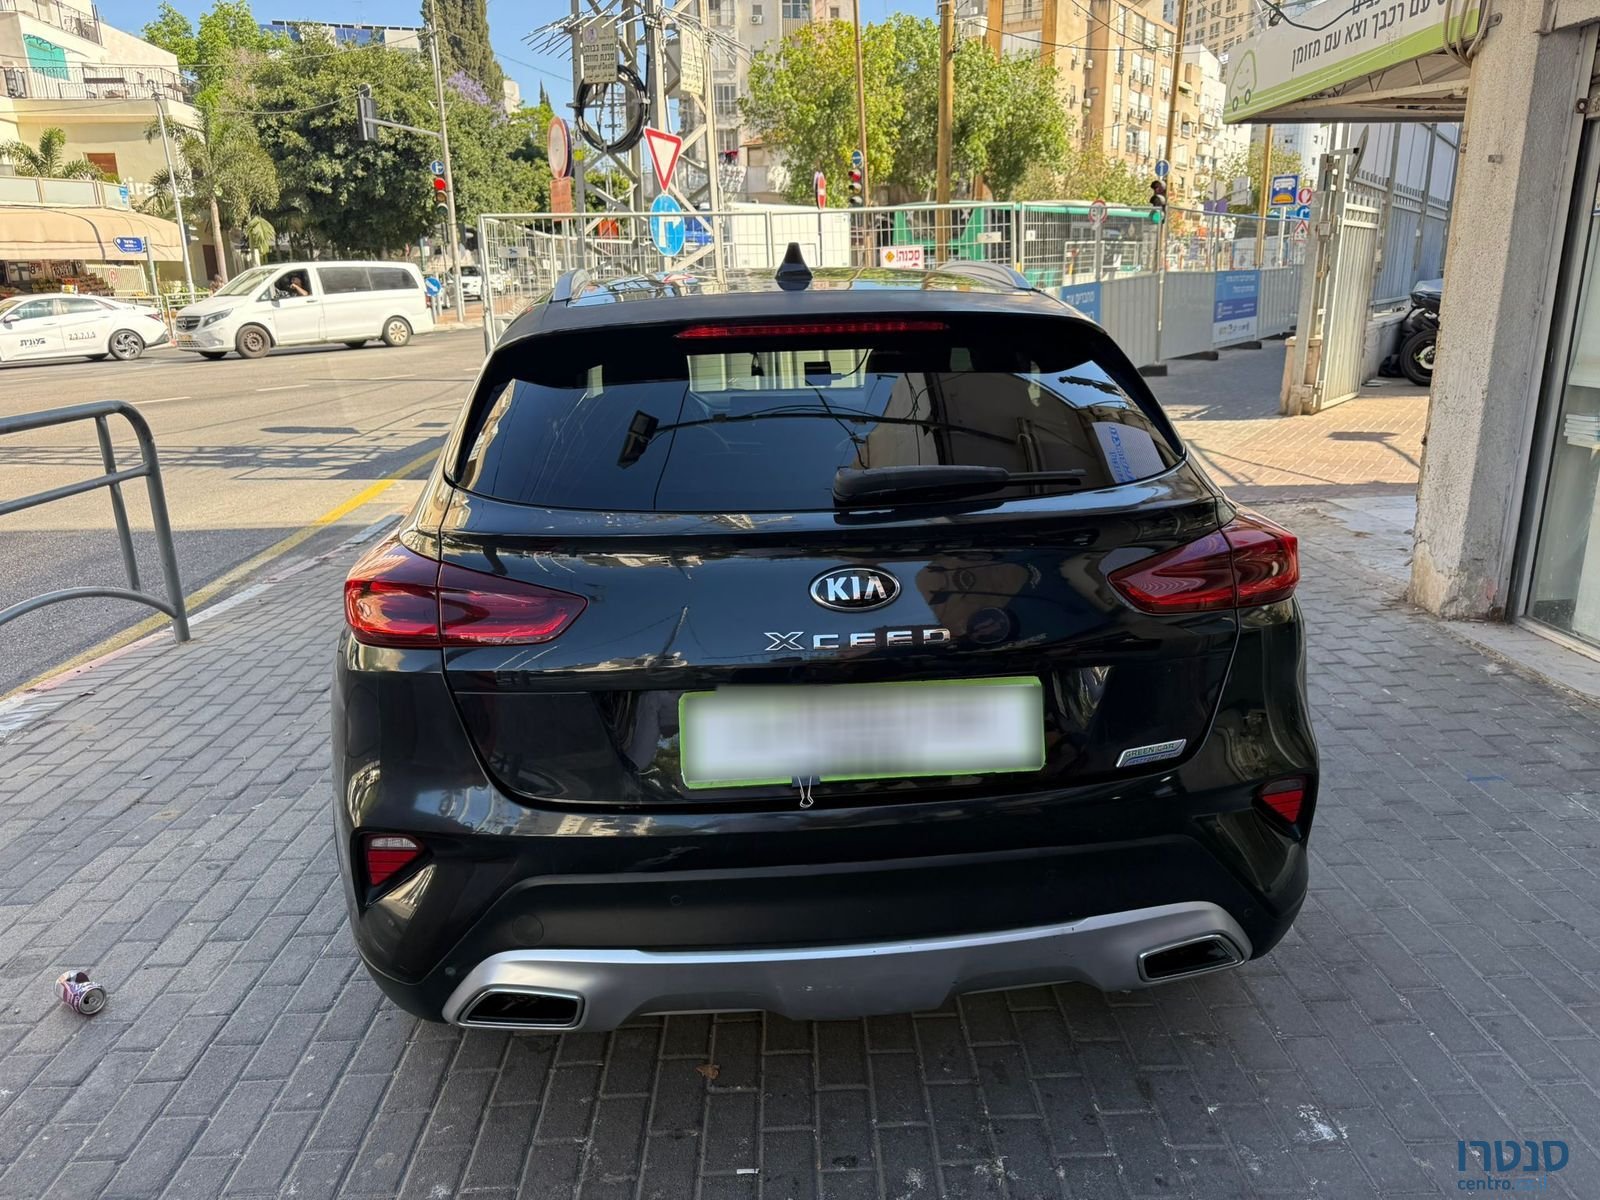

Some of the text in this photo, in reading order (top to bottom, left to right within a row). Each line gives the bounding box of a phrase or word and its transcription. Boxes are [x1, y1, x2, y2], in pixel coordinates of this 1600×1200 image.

[1344, 18, 1368, 45] וצא
[1372, 2, 1405, 39] רכבך
[1291, 37, 1321, 72] מזומן
[1324, 29, 1342, 54] עם
[896, 249, 920, 262] סכנה!
[825, 575, 888, 602] KIA
[764, 628, 952, 651] XCEED
[1126, 746, 1155, 758] GREEN
[1157, 743, 1175, 752] CAR
